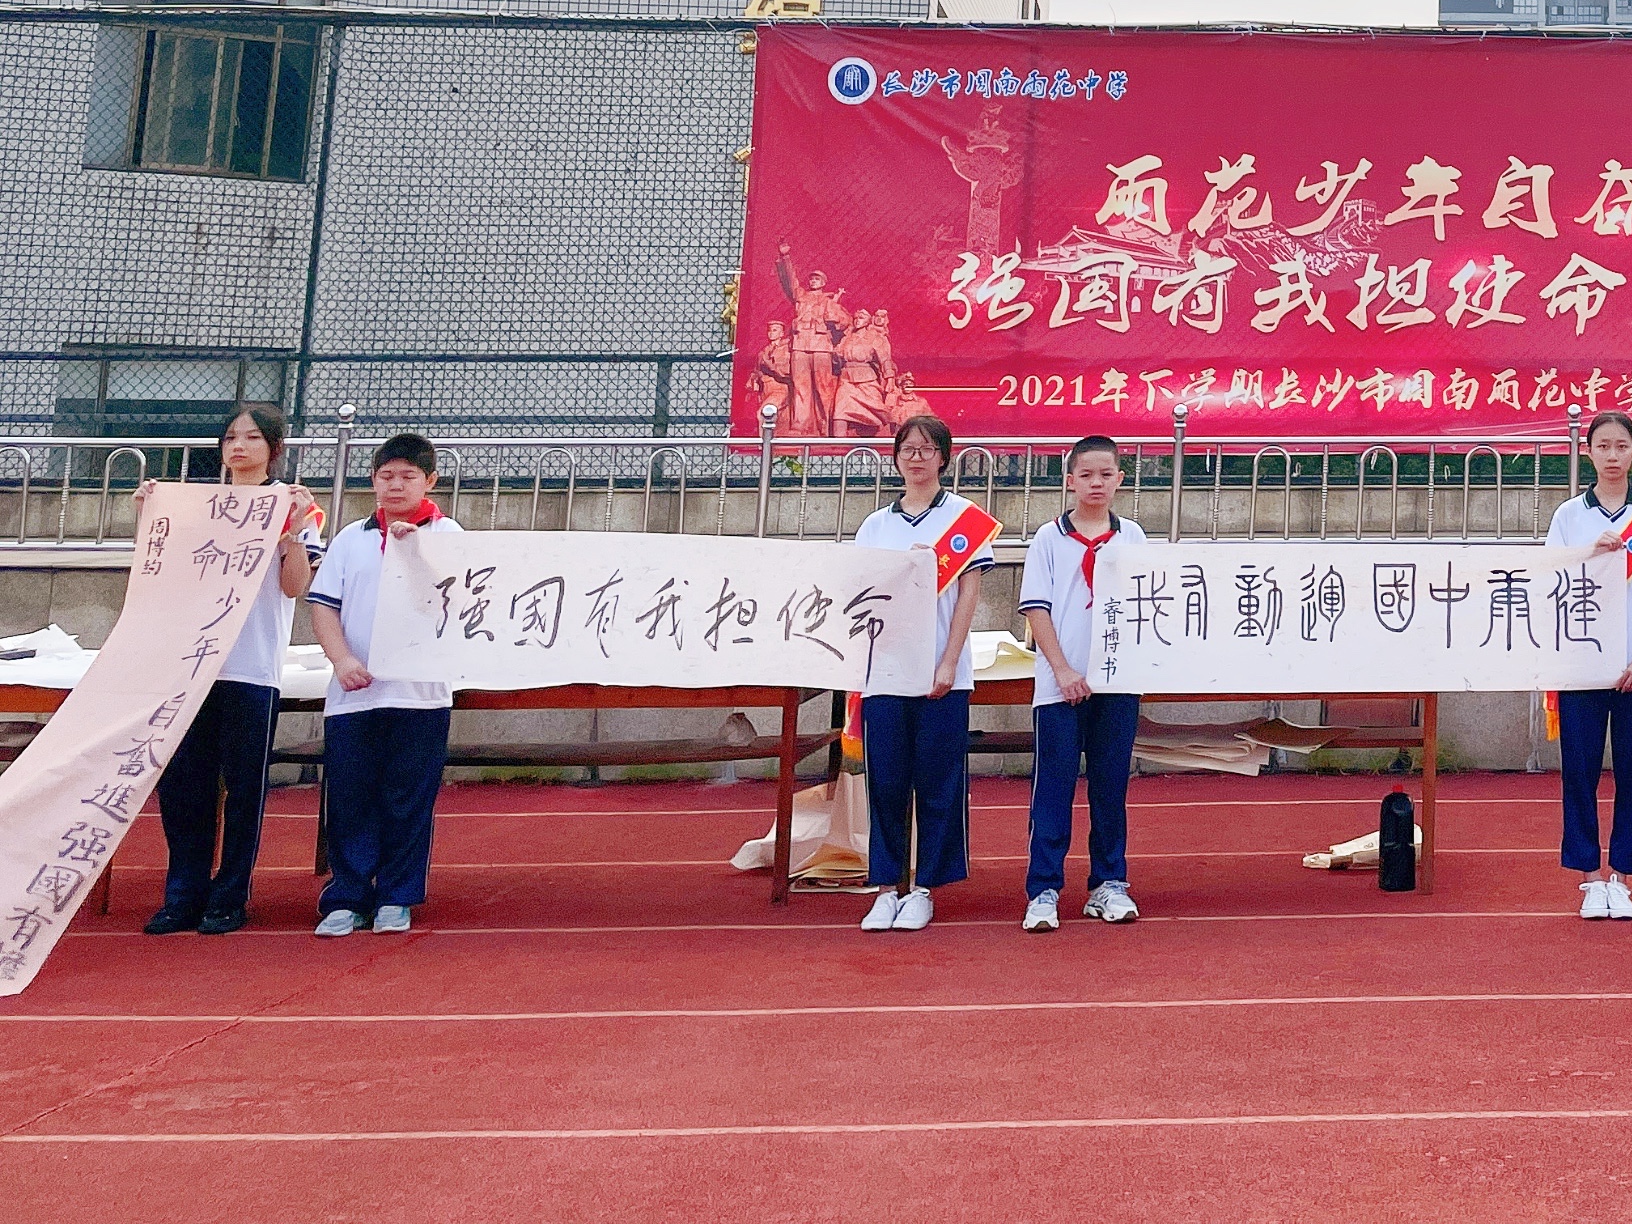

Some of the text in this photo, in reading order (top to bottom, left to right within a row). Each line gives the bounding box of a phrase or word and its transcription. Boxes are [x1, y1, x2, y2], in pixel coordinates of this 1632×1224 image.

[881, 67, 1128, 100] 长沙市周南雨花中学
[948, 250, 1627, 336] 强国有我担使命
